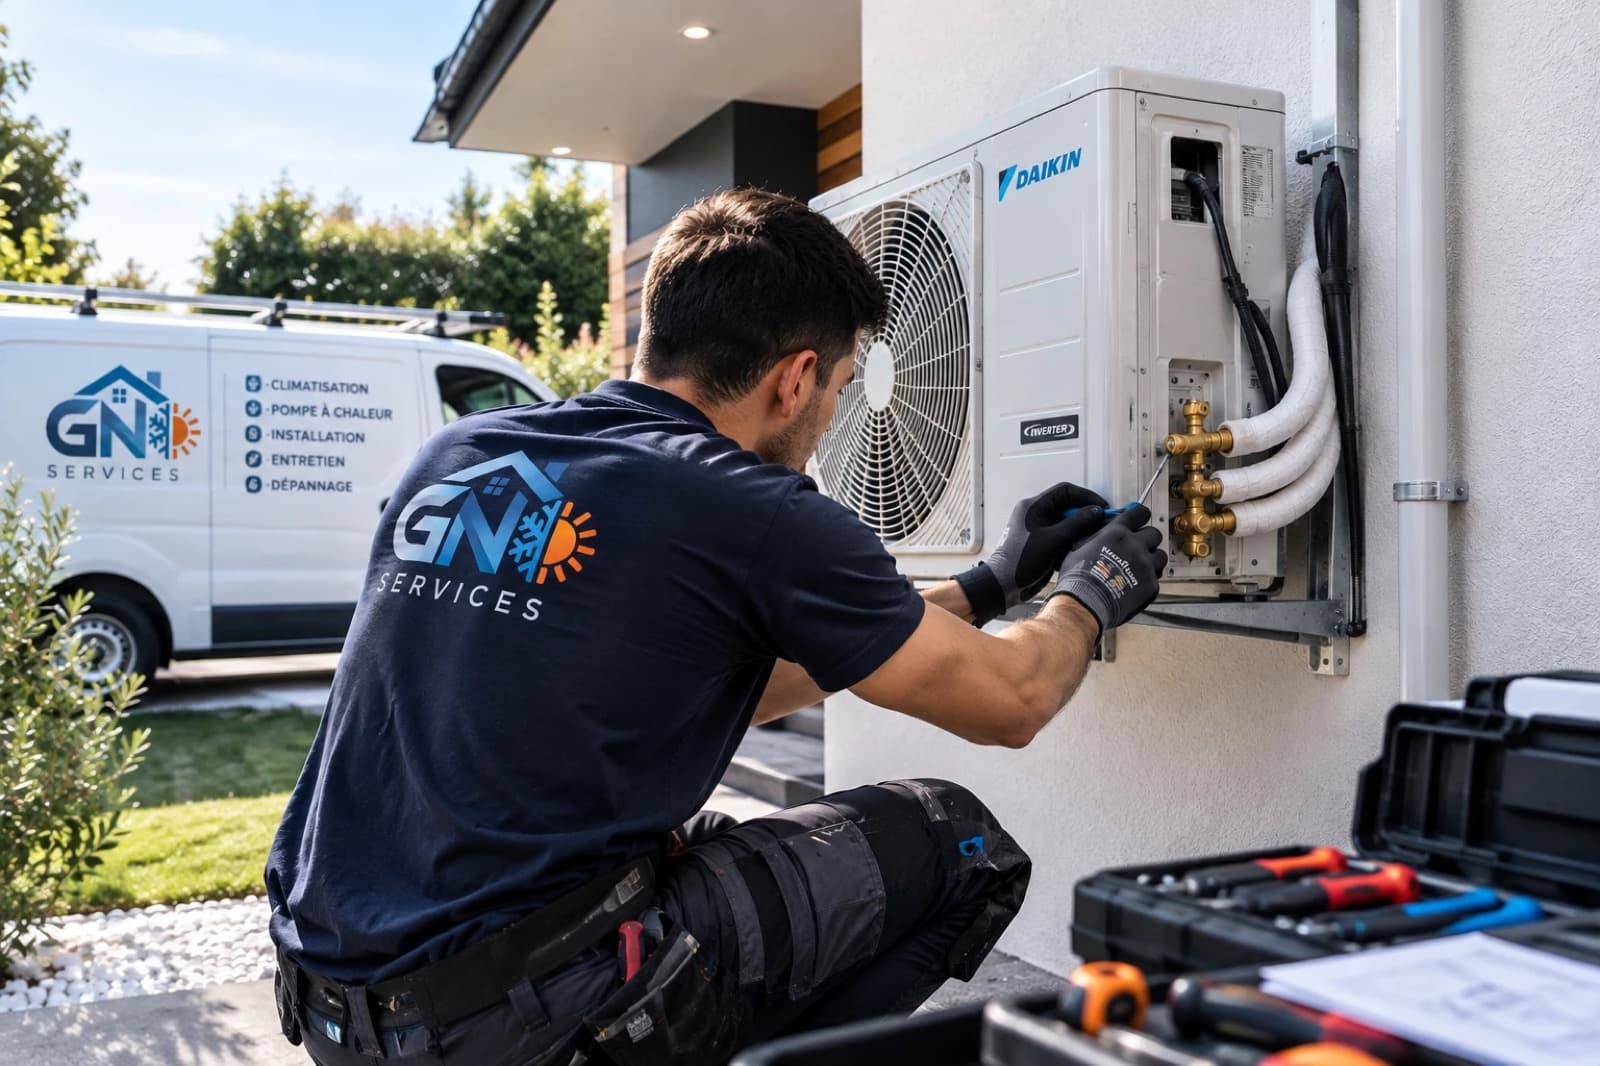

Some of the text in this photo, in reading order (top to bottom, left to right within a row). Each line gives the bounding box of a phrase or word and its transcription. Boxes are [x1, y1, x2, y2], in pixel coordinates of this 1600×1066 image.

[1016, 147, 1081, 190] DAIKIN
[271, 379, 368, 394] CLIMATISATION
[271, 402, 392, 420] POMPE À CHALEUR
[46, 398, 147, 459] GN
[271, 429, 365, 443] INSTALLATION
[271, 454, 345, 467] ENTRETIEN
[47, 464, 179, 482] SERVICES
[271, 478, 352, 492] DÉPANNAGE
[393, 483, 528, 575] GN
[376, 572, 543, 622] SERVICES
